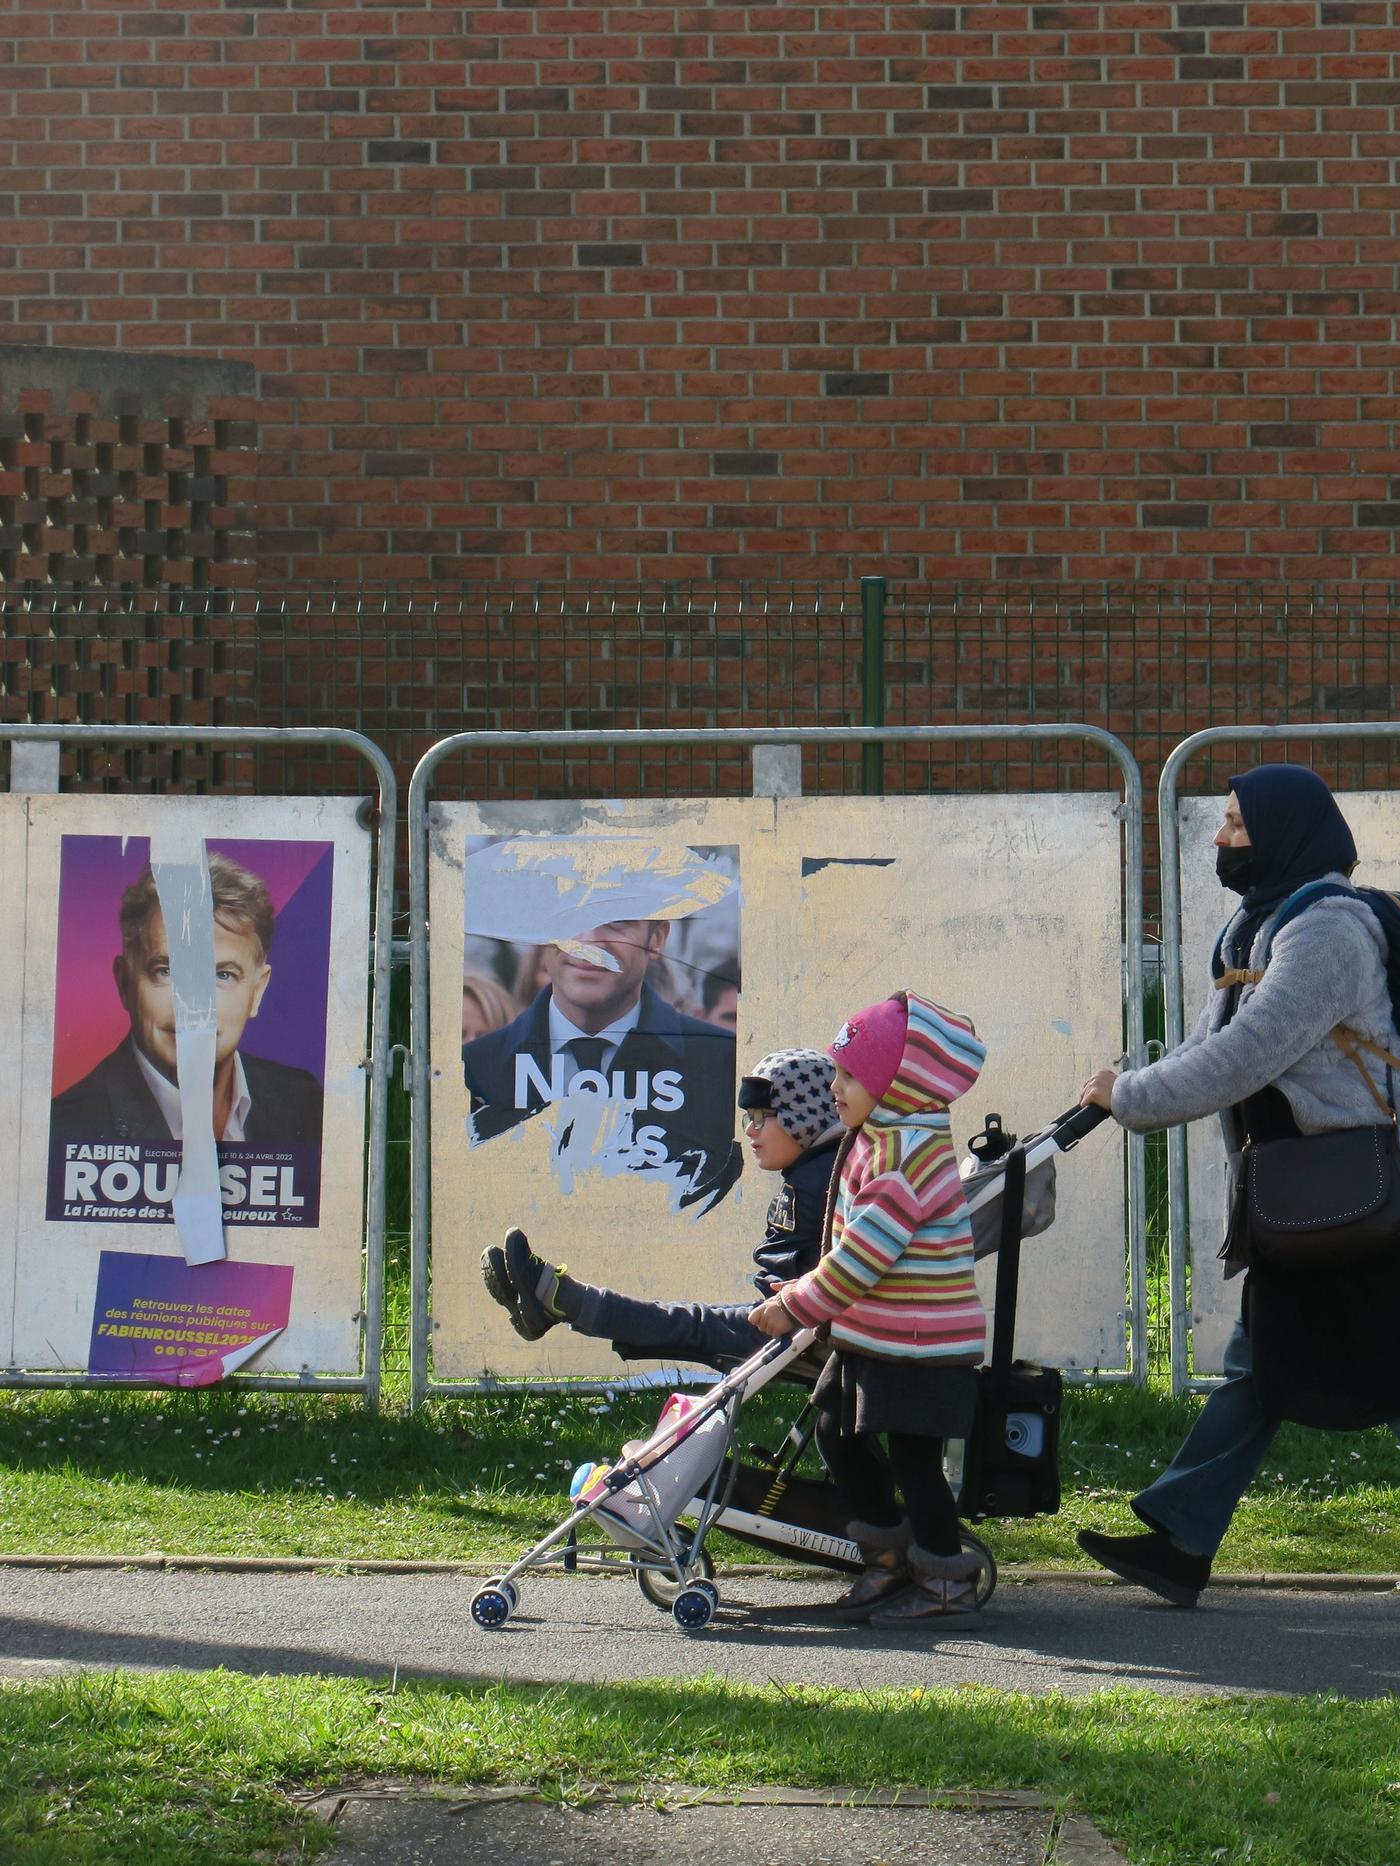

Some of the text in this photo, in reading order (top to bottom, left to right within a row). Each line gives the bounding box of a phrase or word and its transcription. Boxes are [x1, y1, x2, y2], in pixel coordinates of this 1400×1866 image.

[514, 1053, 685, 1112] Nous
[65, 1144, 140, 1161] FABIEN
[145, 1149, 178, 1158] ÉLECTION
[64, 1161, 305, 1206] ROUSEL
[64, 1204, 83, 1217] La
[83, 1204, 137, 1218] France
[138, 1206, 166, 1219] des
[222, 1211, 278, 1222] eureux
[105, 1308, 270, 1331] des réunions publiques sur
[133, 1298, 252, 1319] Retrouvez les dates
